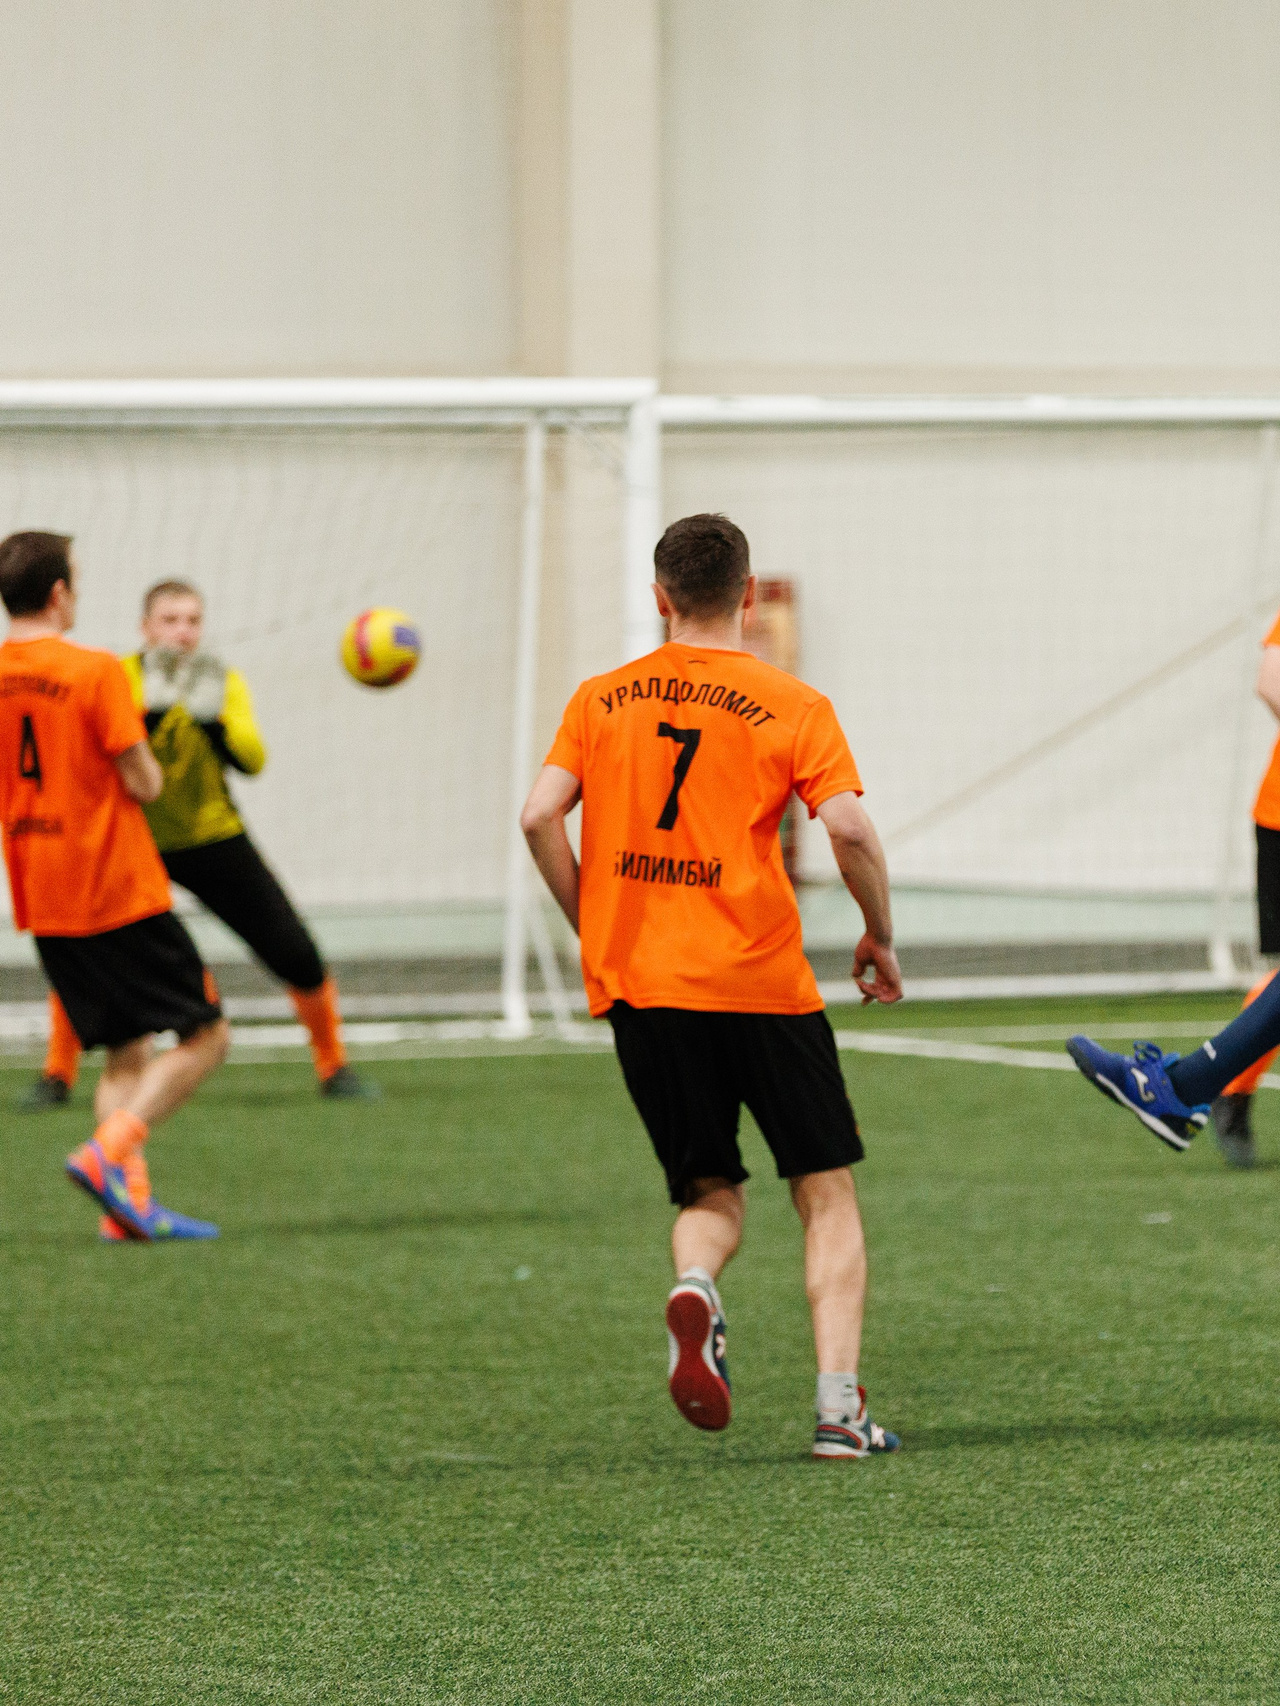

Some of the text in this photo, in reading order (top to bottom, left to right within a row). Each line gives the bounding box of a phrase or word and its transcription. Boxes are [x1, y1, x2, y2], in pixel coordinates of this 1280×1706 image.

[600, 677, 776, 727] УРАЛДОЛОМИТ
[20, 715, 43, 792] 4
[656, 722, 702, 831] 7
